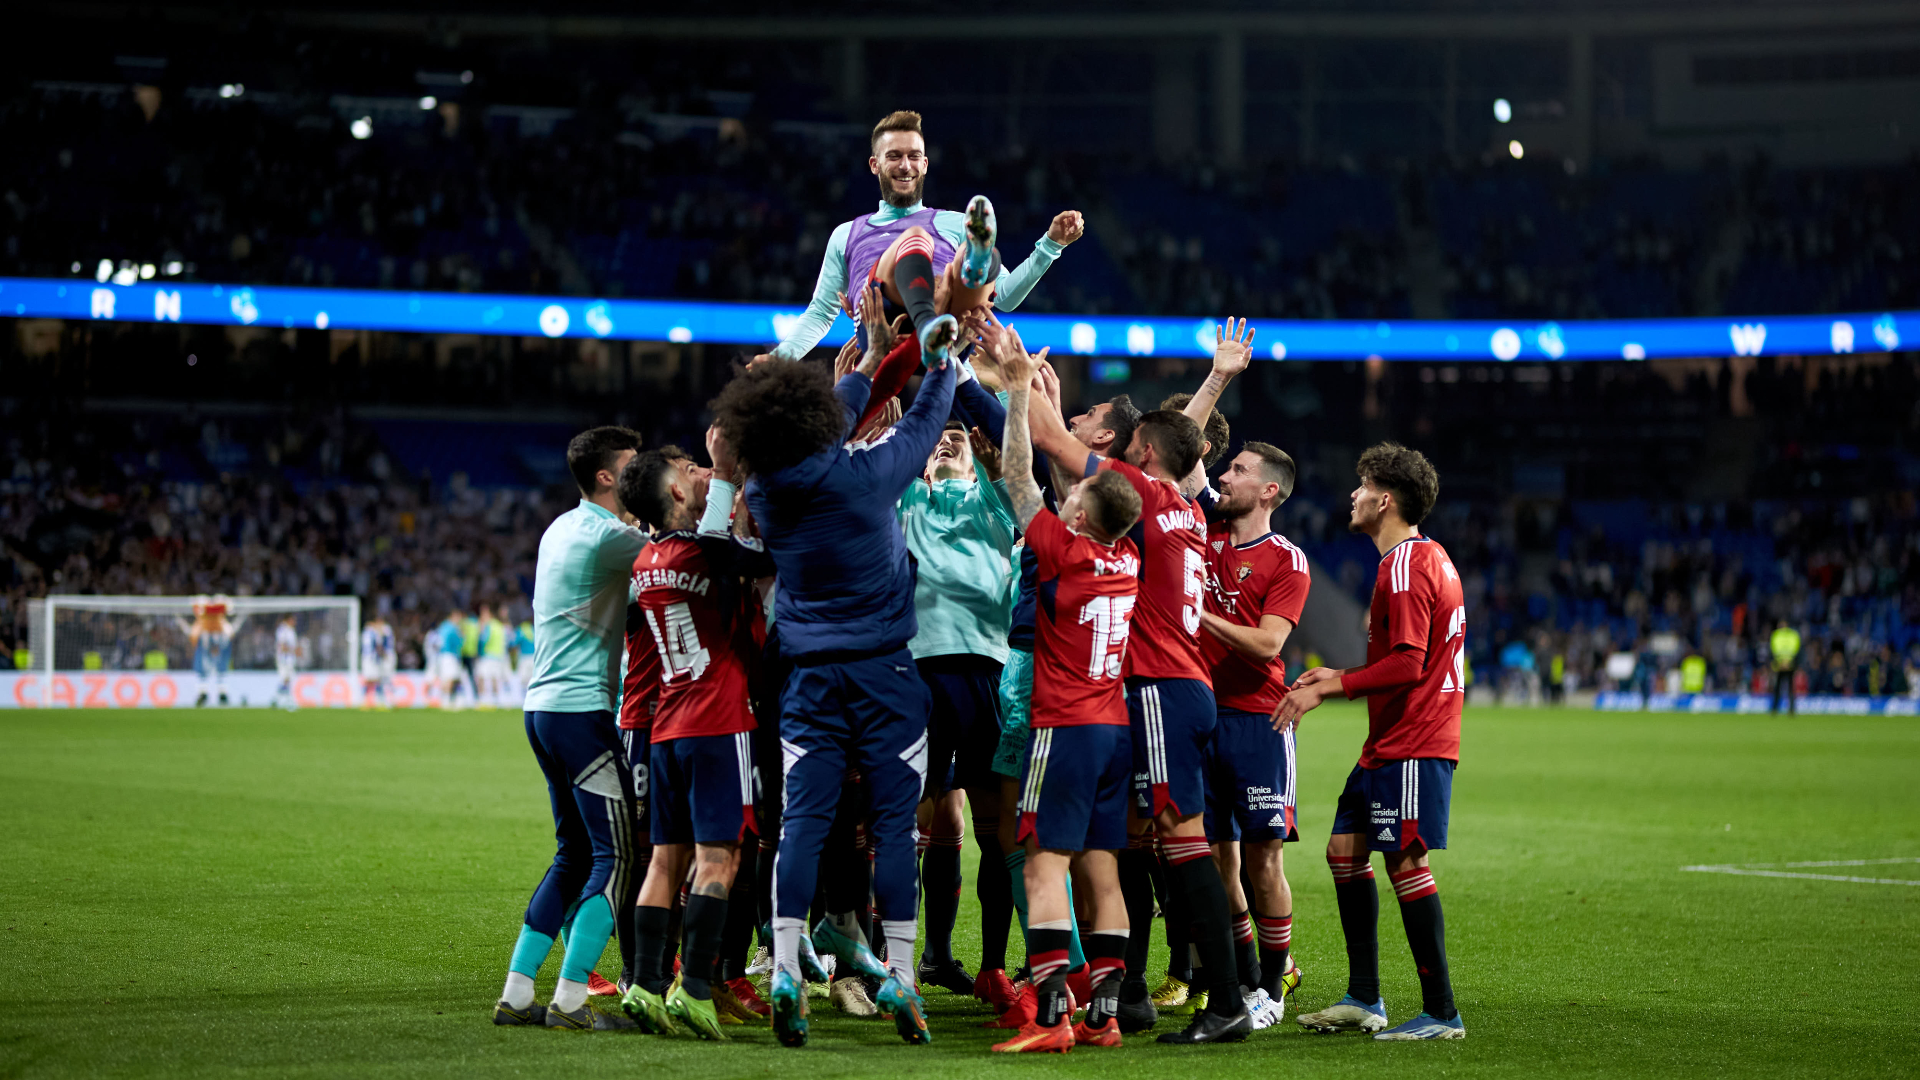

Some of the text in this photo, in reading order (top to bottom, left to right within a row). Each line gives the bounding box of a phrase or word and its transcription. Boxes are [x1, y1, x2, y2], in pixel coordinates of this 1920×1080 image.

[1156, 510, 1196, 533] DAVID
[652, 568, 710, 596] GARCÍA
[1182, 547, 1203, 636] 5
[645, 602, 711, 687] 14
[1078, 595, 1137, 680] 15
[13, 675, 178, 708] CAZOO
[1249, 803, 1258, 811] de
